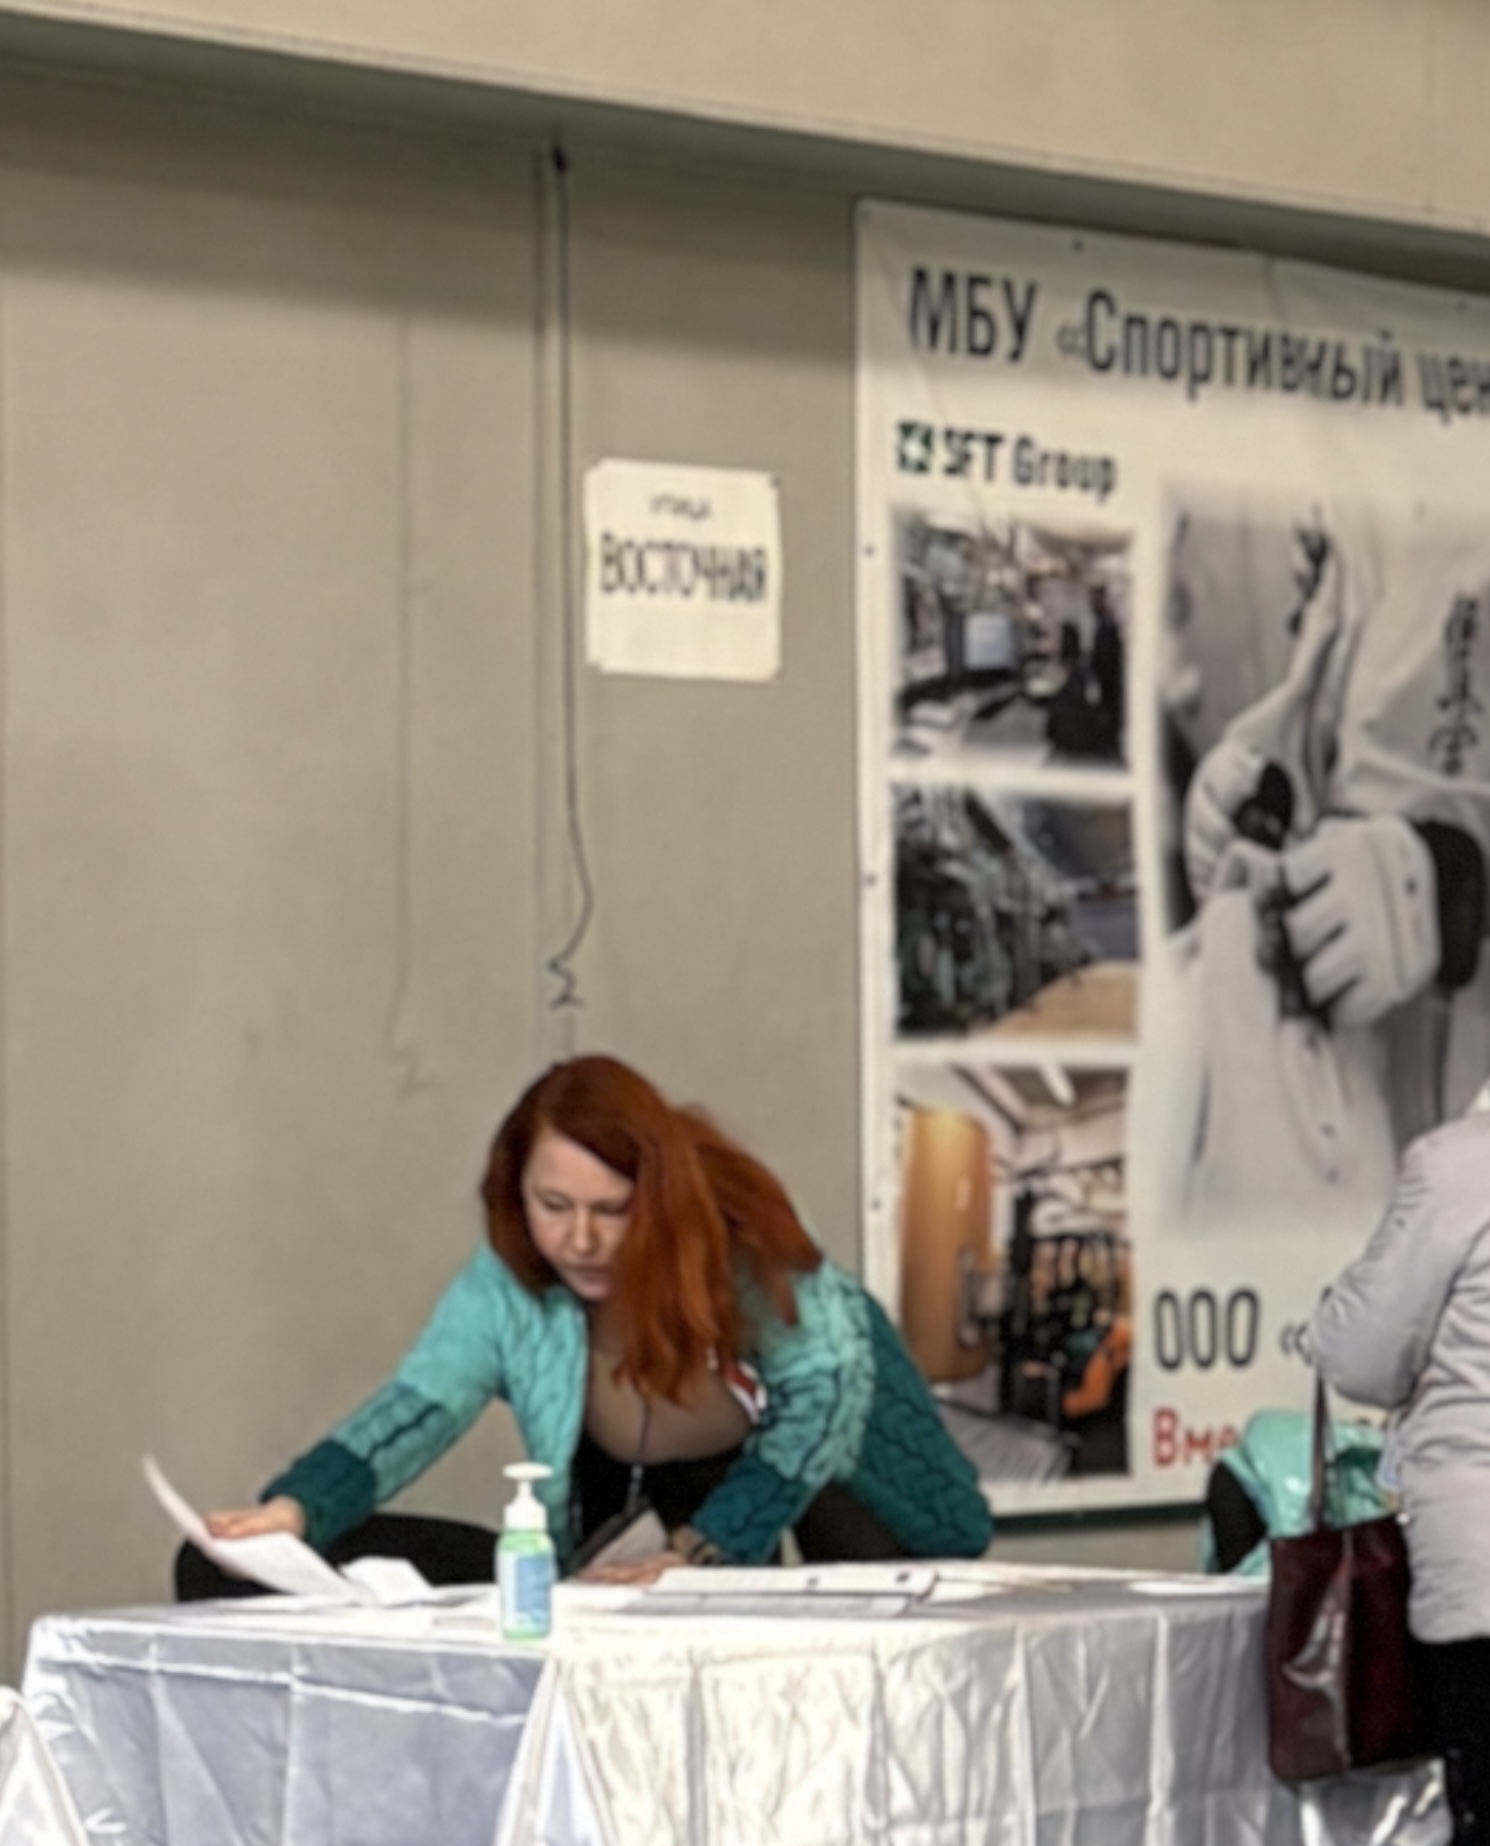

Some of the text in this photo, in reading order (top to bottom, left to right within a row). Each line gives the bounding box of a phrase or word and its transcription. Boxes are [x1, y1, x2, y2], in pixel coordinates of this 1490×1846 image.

[908, 266, 1038, 365] МБУ
[1056, 288, 1404, 406] «Спортивный
[1012, 437, 1116, 503] Group
[601, 530, 766, 604] ВОСТОЧНАЯ
[1154, 1288, 1260, 1371] ООО
